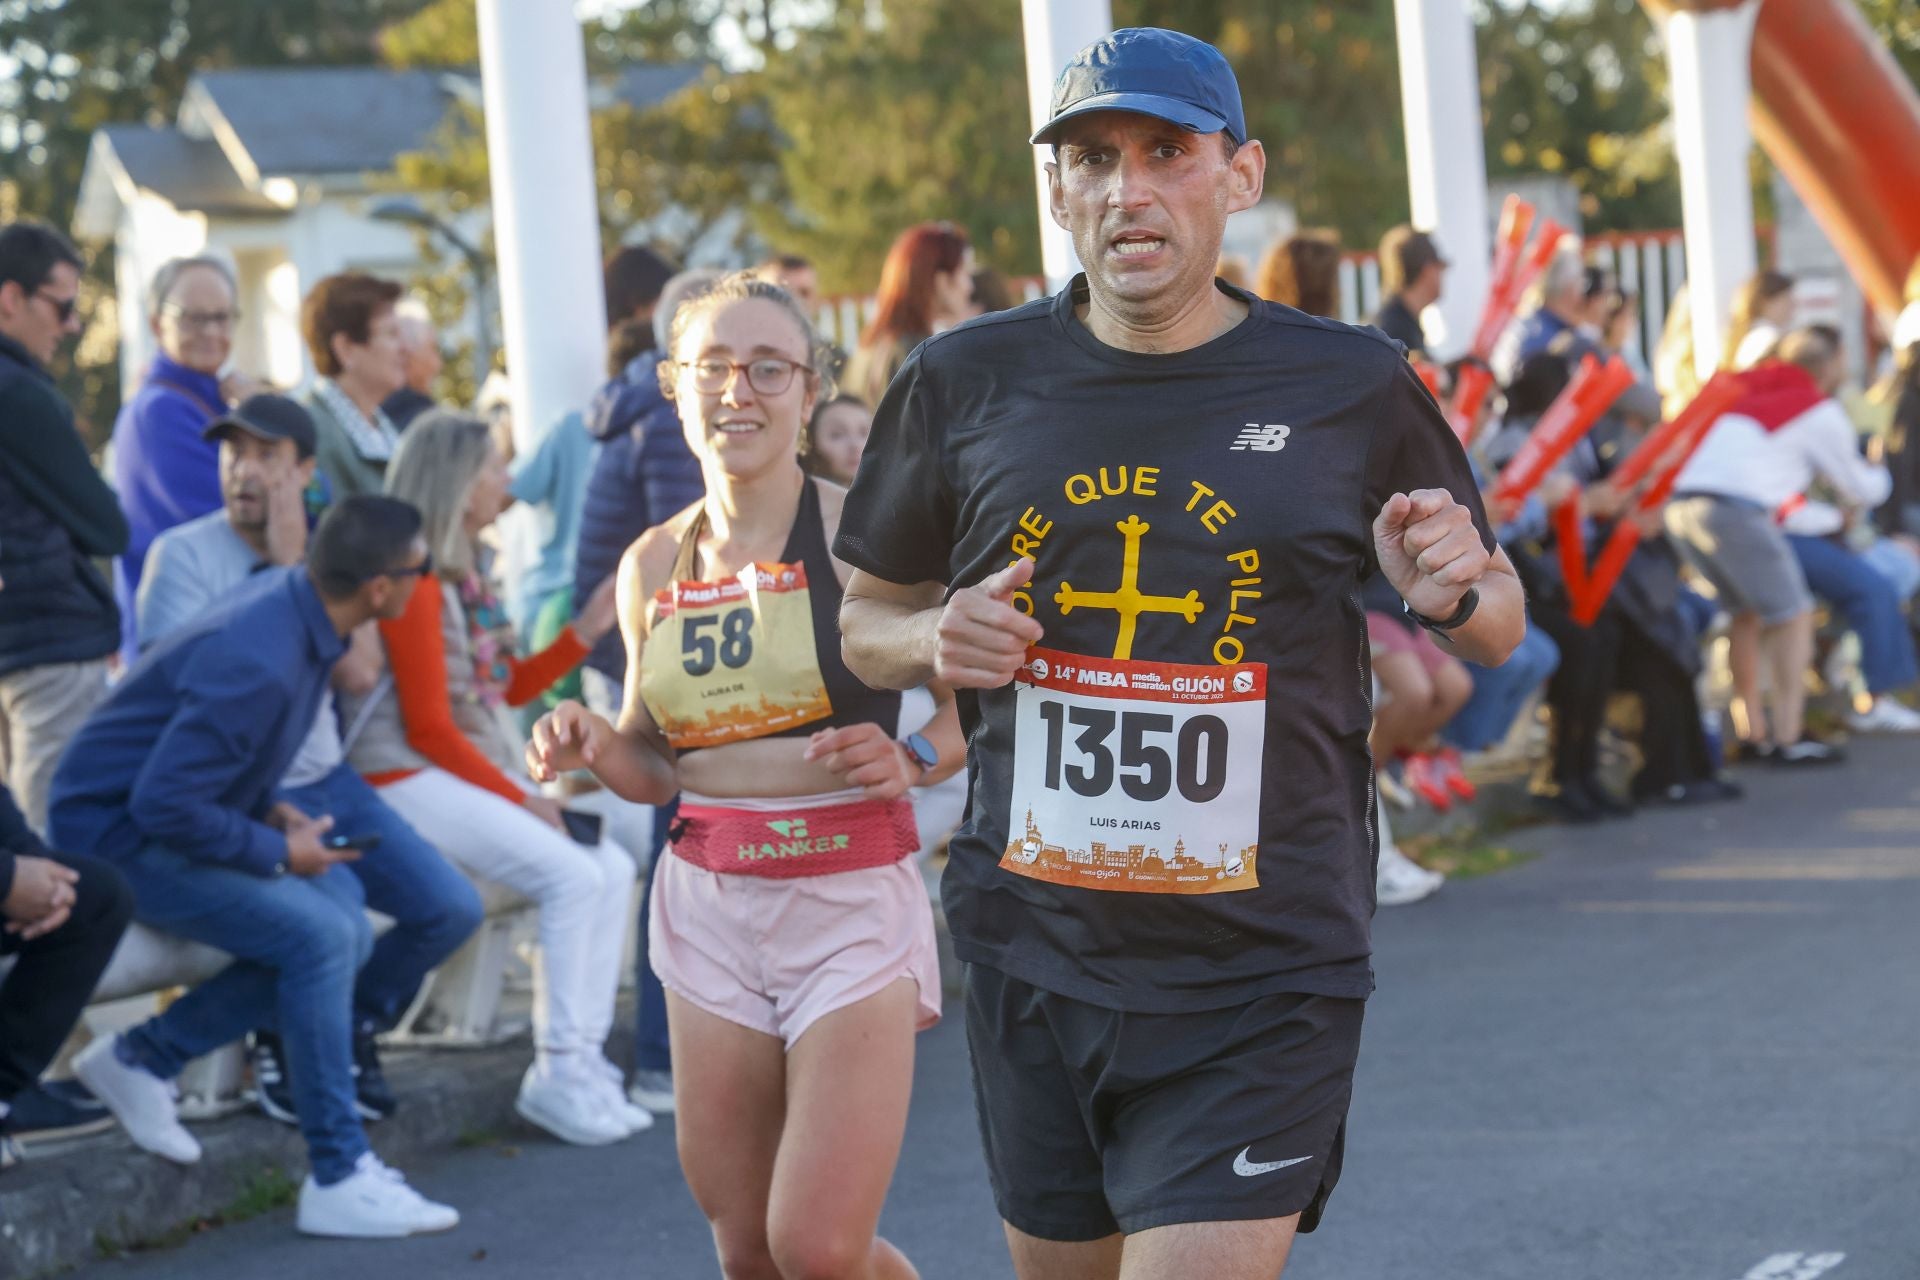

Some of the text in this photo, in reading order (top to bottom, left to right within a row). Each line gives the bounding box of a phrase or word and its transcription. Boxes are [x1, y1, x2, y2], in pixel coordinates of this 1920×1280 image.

[1011, 465, 1262, 666] ORE QUE TE PILLO
[681, 607, 755, 677] 58
[701, 683, 745, 698] LAURA DE
[1076, 668, 1129, 688] MBA
[1131, 672, 1161, 683] media
[1172, 675, 1225, 693] GIJÓN
[1131, 680, 1171, 692] maratón
[1040, 700, 1229, 804] 1350
[1090, 816, 1161, 831] LUIS ARIAS
[738, 834, 849, 861] HANKER
[1096, 868, 1120, 879] gijón
